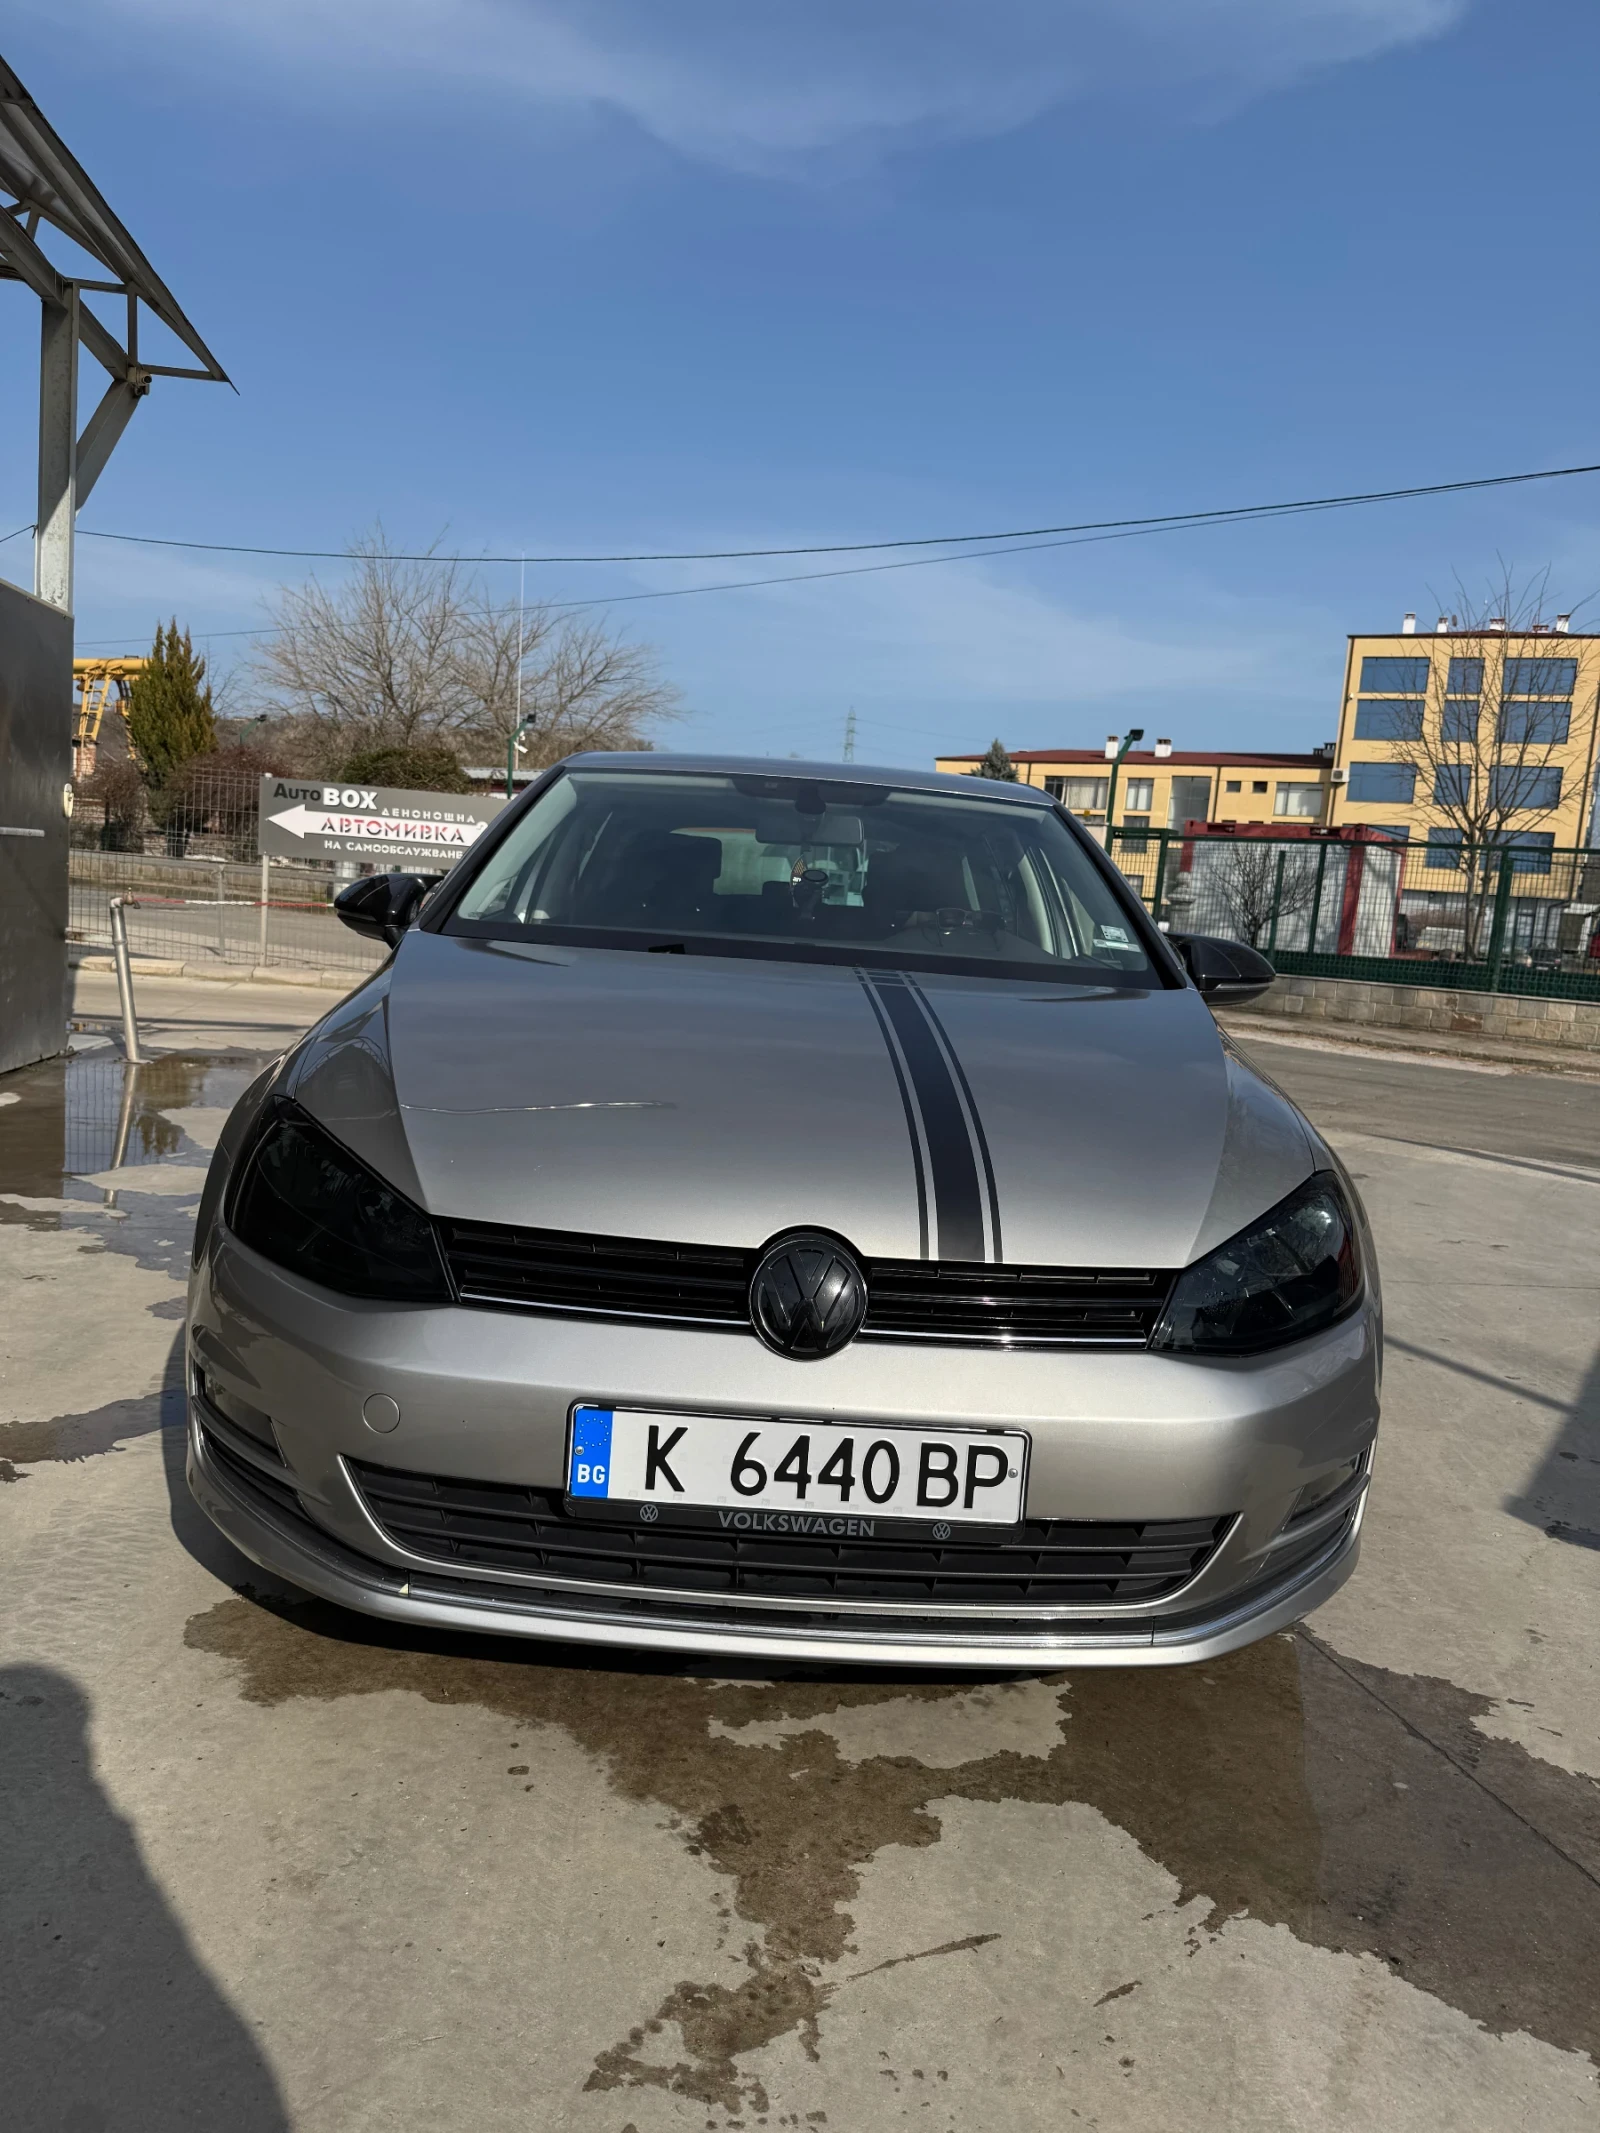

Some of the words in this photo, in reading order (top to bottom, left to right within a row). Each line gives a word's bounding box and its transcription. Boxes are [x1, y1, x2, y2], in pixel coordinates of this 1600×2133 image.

[321, 817, 464, 843] АВТОМИВКА
[324, 839, 341, 850] НА
[346, 841, 463, 859] САМООБСЛУЖВАНЕ
[577, 1464, 606, 1485] BG
[644, 1425, 689, 1493] K
[730, 1432, 900, 1504] 6440
[917, 1441, 1008, 1509] BP
[717, 1510, 875, 1537] VOLKSWAGEN
